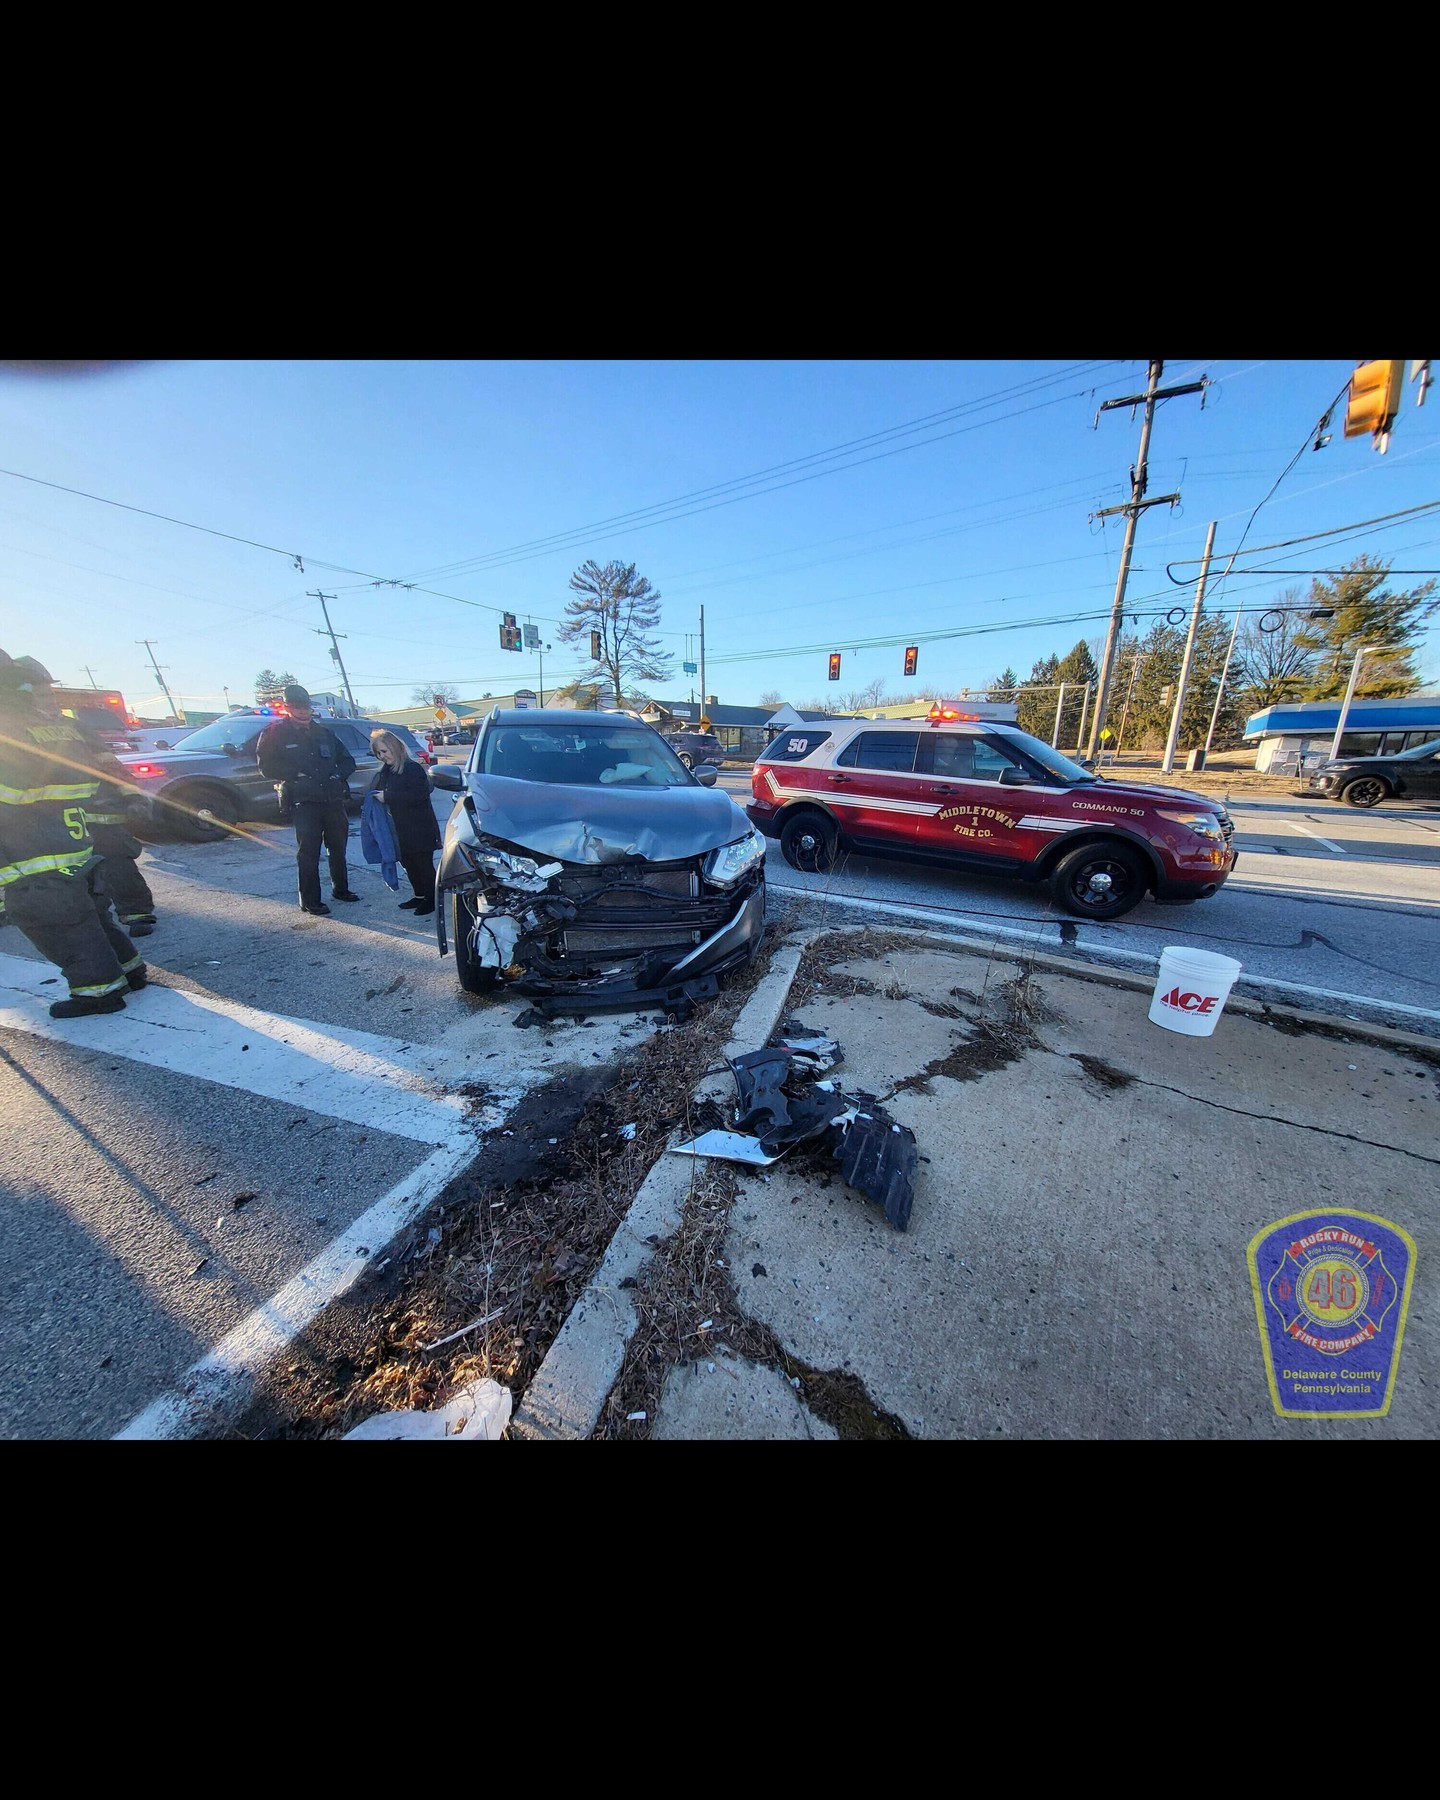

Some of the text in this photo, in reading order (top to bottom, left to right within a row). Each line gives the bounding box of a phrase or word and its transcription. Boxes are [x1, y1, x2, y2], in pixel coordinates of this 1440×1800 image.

[787, 738, 809, 753] 50
[1072, 801, 1145, 817] COMMAND 50
[939, 806, 1016, 828] MIDDLETOWN
[971, 816, 979, 827] 1
[953, 824, 994, 837] FIRE CO.
[1160, 986, 1220, 1013] ACE
